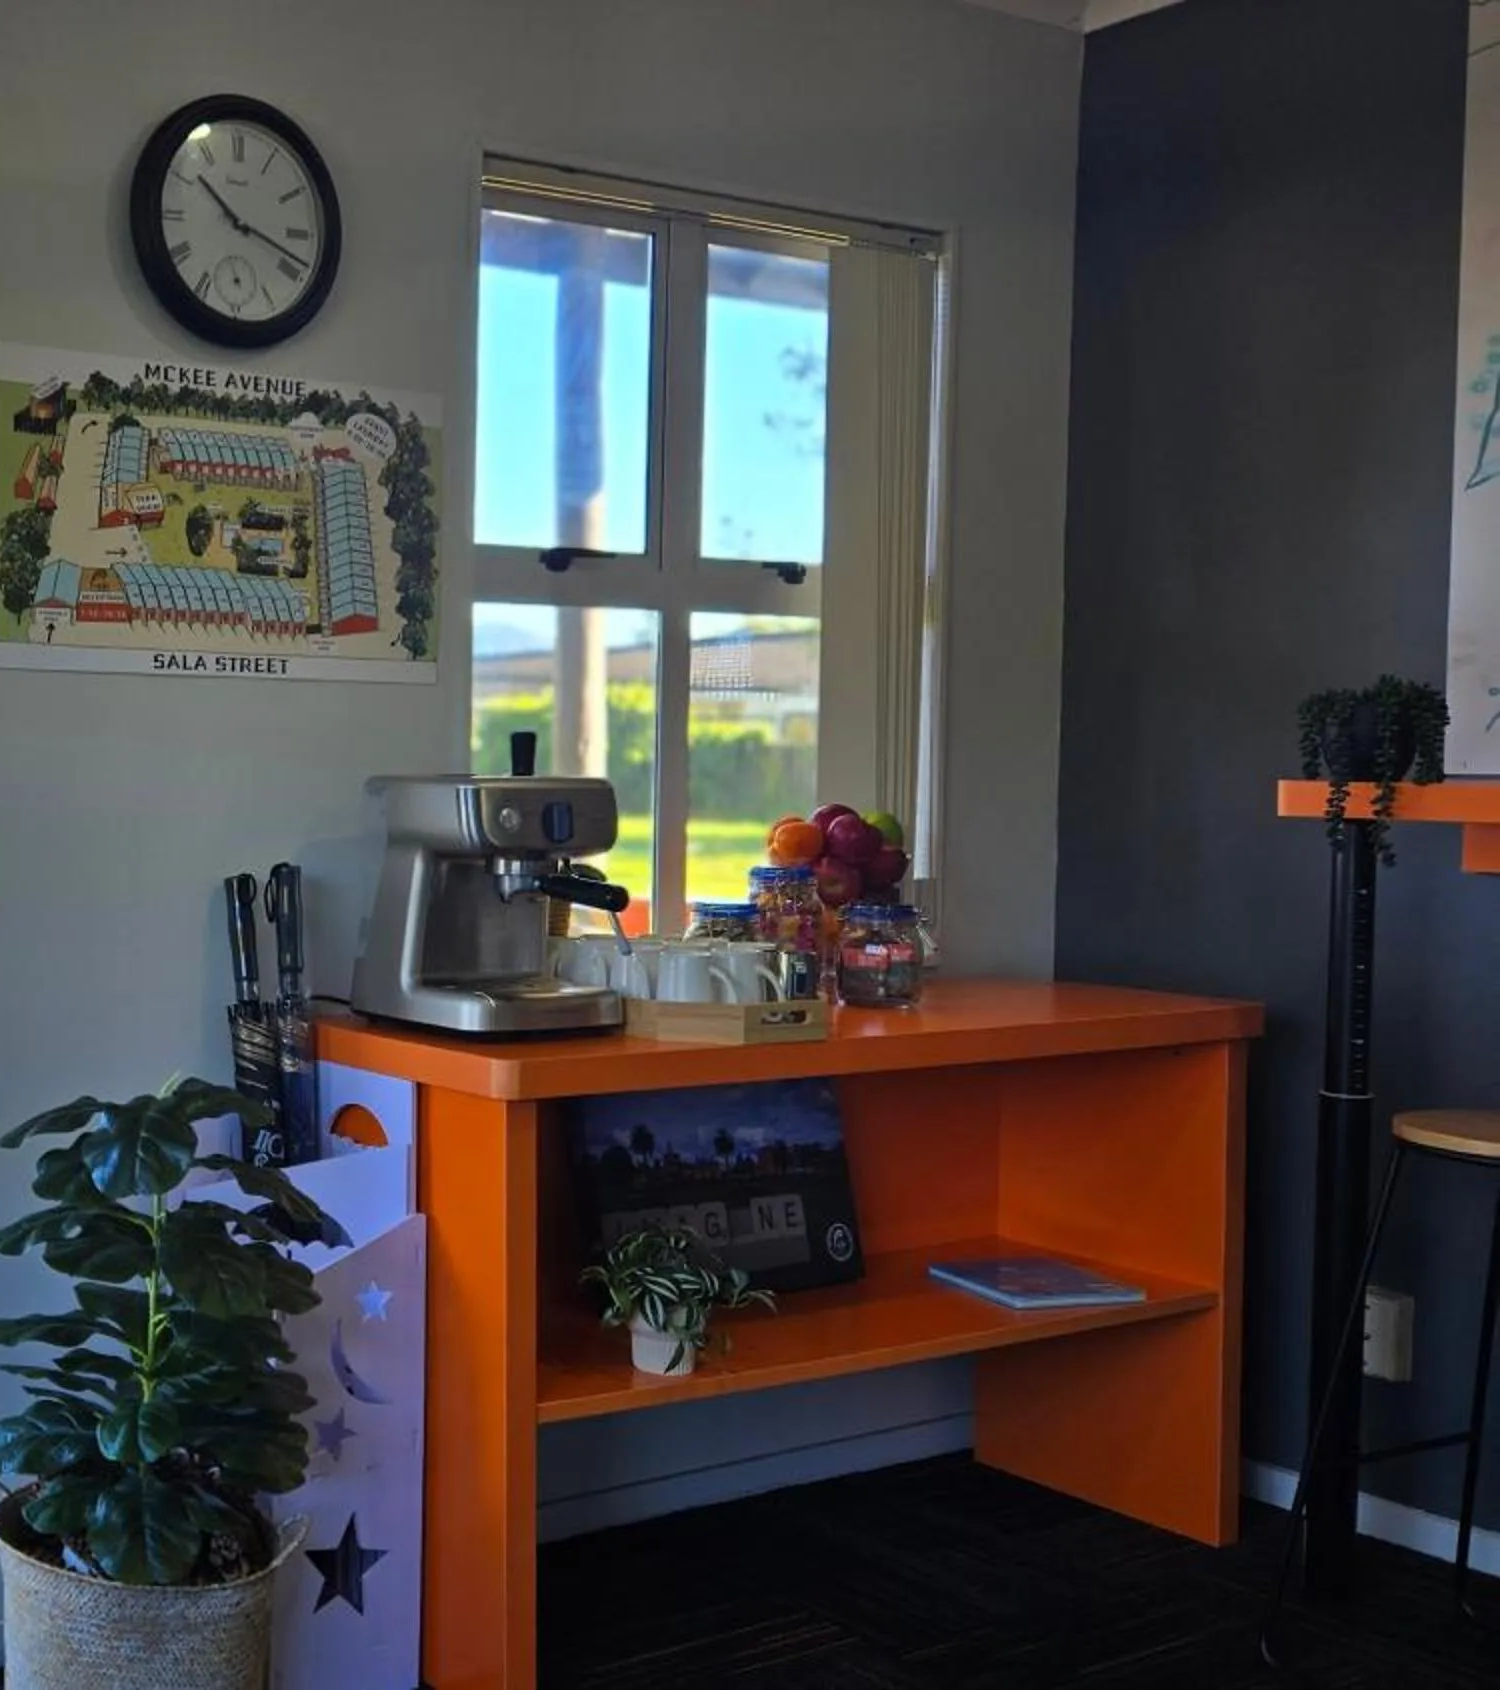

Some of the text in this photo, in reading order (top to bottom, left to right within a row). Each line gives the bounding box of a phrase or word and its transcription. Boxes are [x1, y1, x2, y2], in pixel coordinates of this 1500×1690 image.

[144, 363, 307, 397] MCKEE AVENUE
[153, 653, 290, 675] SALA STREET
